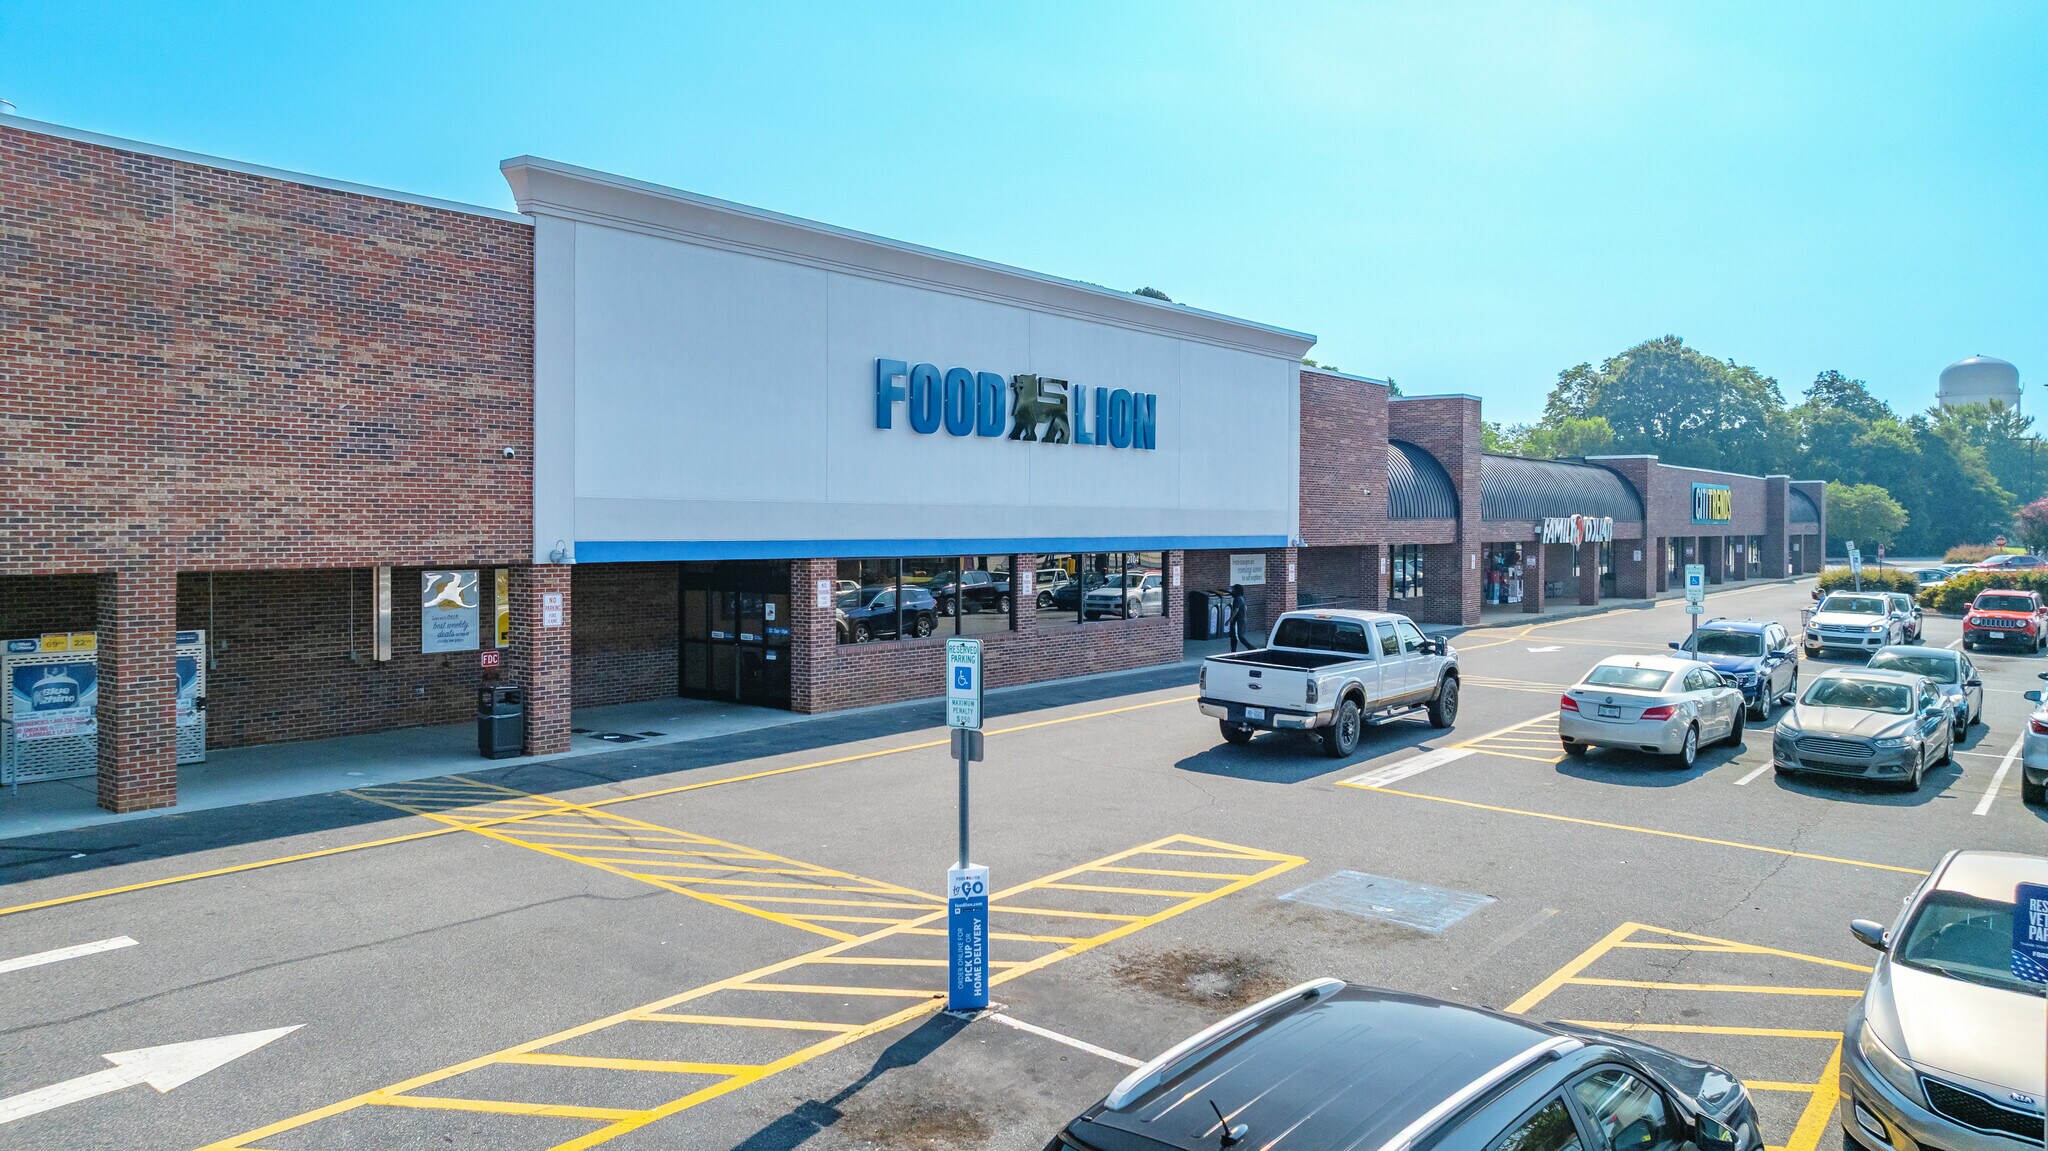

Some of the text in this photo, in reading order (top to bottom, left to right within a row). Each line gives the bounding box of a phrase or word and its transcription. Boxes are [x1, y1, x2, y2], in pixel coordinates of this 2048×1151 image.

[874, 357, 1157, 450] FOOD LION
[1126, 555, 1139, 564] 2104
[548, 596, 557, 604] NO
[432, 619, 469, 631] best weekly
[436, 629, 455, 638] deals
[949, 645, 977, 655] RESERVED
[483, 654, 498, 664] FDC
[951, 655, 976, 664] PARKING
[43, 687, 71, 695] Blue
[952, 699, 975, 707] MAXIMUM
[953, 706, 973, 715] PENALTY
[956, 715, 971, 723] $250
[23, 725, 49, 733] SMOKING
[22, 730, 55, 738] FLAMMABLE
[961, 881, 984, 898] GO
[2029, 898, 2048, 913] RES
[965, 932, 972, 943] OR
[965, 944, 972, 958] UP
[974, 918, 982, 996] HOME DELIVERY
[2011, 1091, 2033, 1104] KIA
